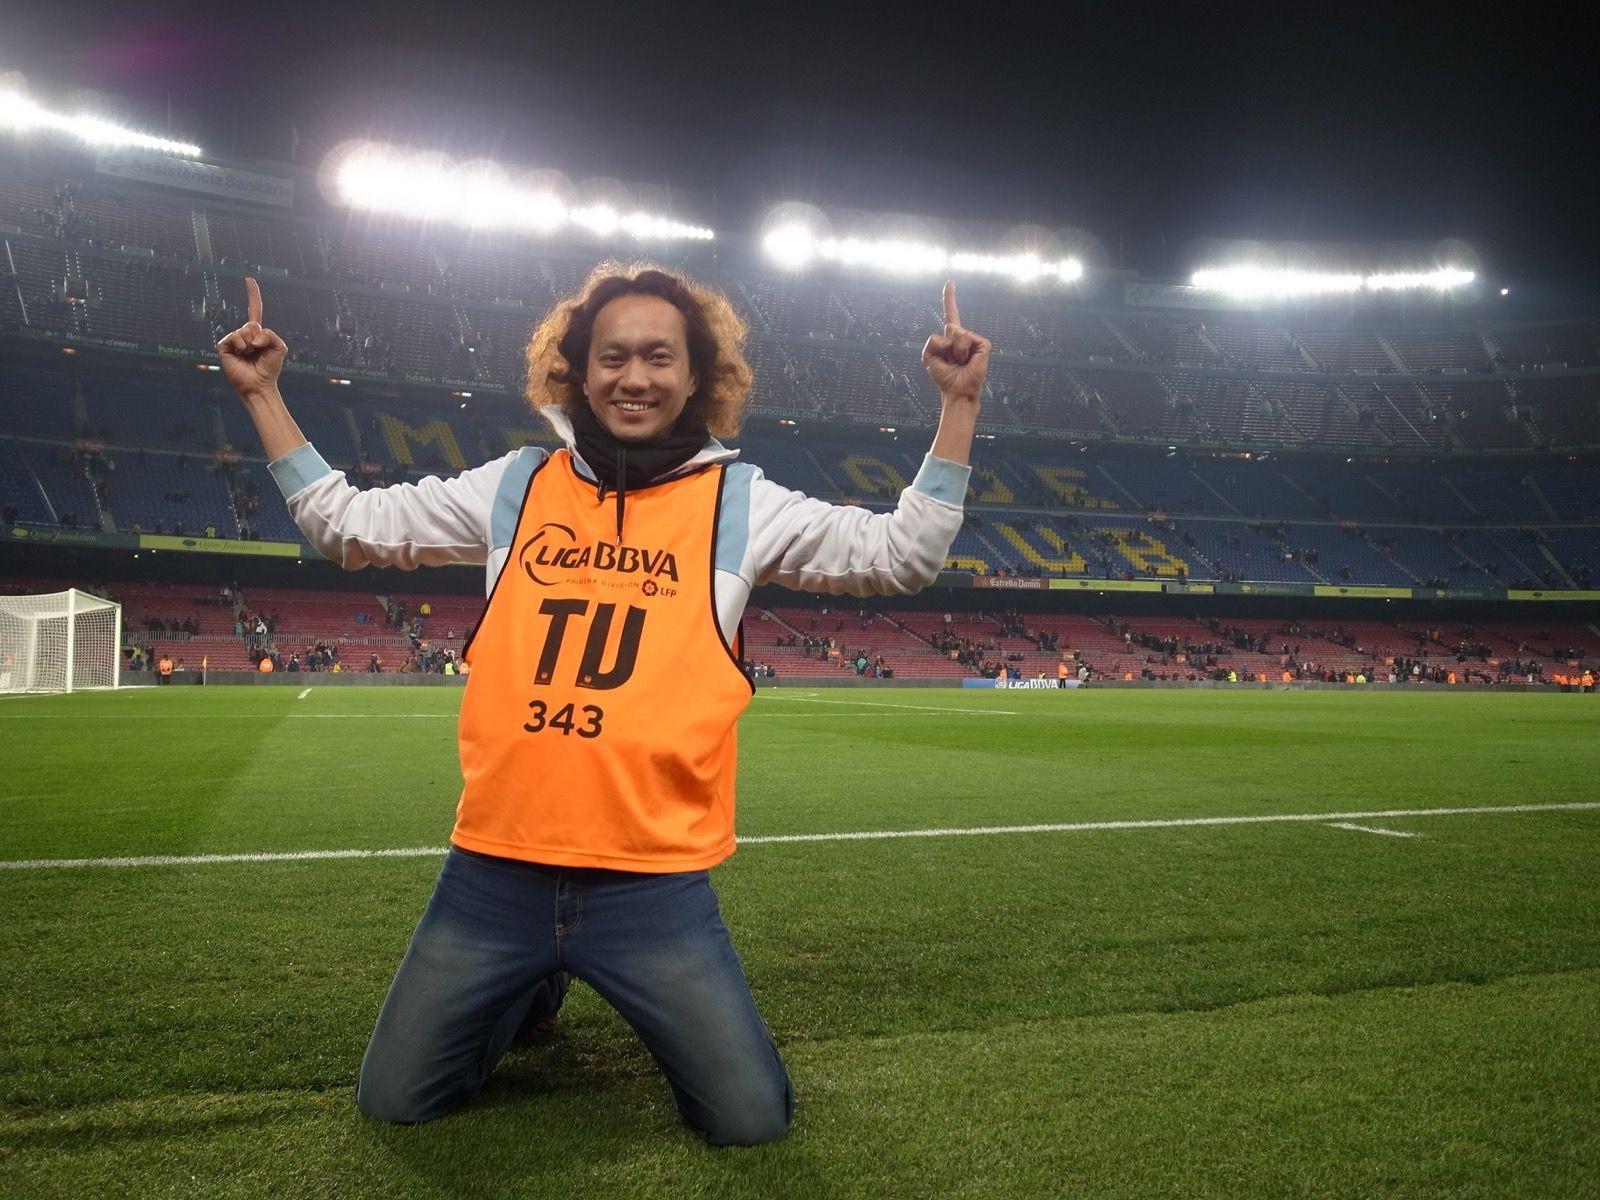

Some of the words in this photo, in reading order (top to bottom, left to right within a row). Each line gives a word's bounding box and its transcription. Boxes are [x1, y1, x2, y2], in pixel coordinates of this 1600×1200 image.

[660, 586, 677, 598] LFP
[990, 577, 1017, 587] Estrella
[1018, 579, 1041, 588] Damm
[534, 598, 647, 690] TU
[523, 699, 605, 739] 343
